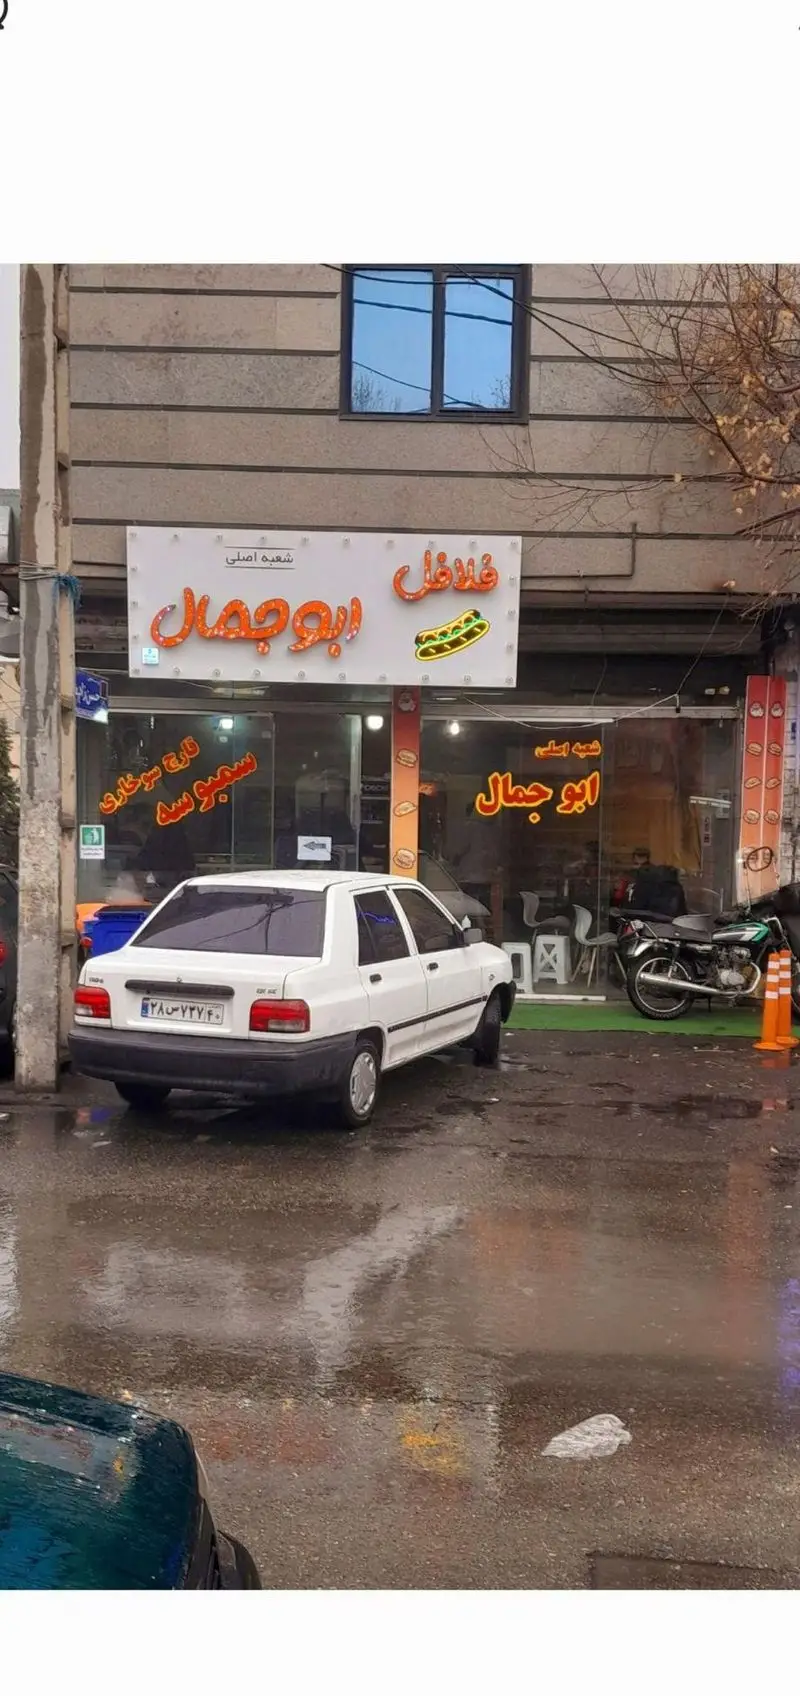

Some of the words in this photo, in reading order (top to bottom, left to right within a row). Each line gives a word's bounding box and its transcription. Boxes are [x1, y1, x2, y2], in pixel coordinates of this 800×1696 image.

[225, 551, 258, 565] اصلی
[261, 552, 294, 566] شعبه
[393, 549, 499, 602] فلافل
[535, 740, 570, 760] اصلی
[572, 740, 602, 759] شعبه
[475, 771, 553, 824] جمال
[556, 770, 600, 813] ابو
